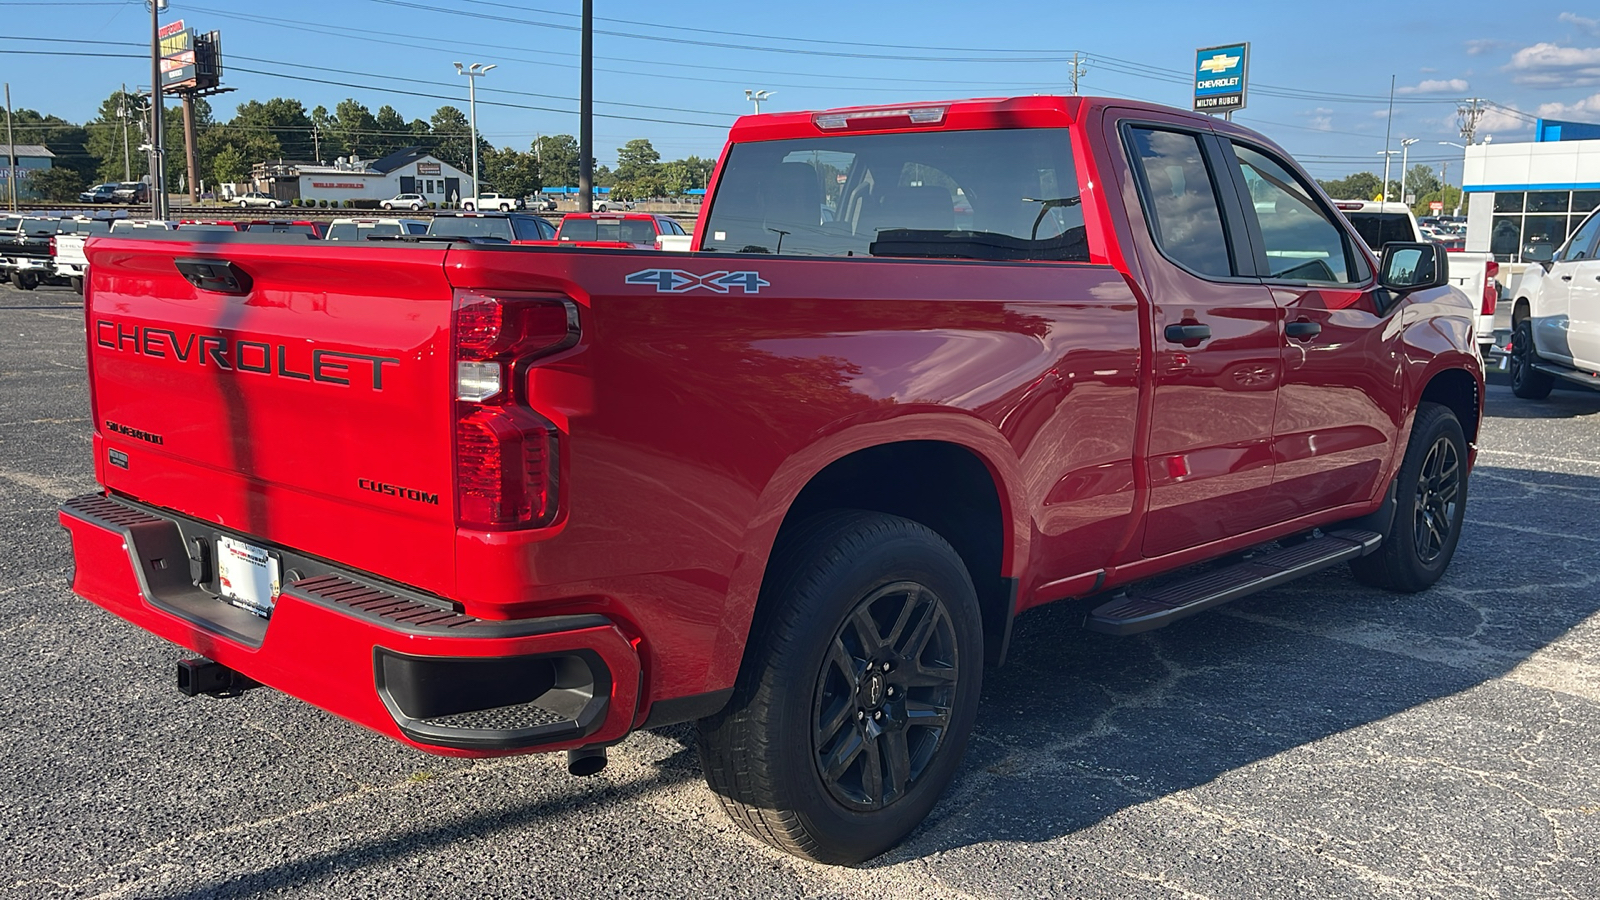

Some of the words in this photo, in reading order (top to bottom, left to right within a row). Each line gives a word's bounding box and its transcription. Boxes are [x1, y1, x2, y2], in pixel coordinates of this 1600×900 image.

[1197, 77, 1239, 89] CHEVROLET
[1196, 98, 1218, 107] MILTON
[1218, 96, 1239, 105] RUBEN
[97, 319, 400, 392] CHEVROLET
[105, 420, 164, 446] SILVERADO
[358, 478, 439, 505] CUSTOM
